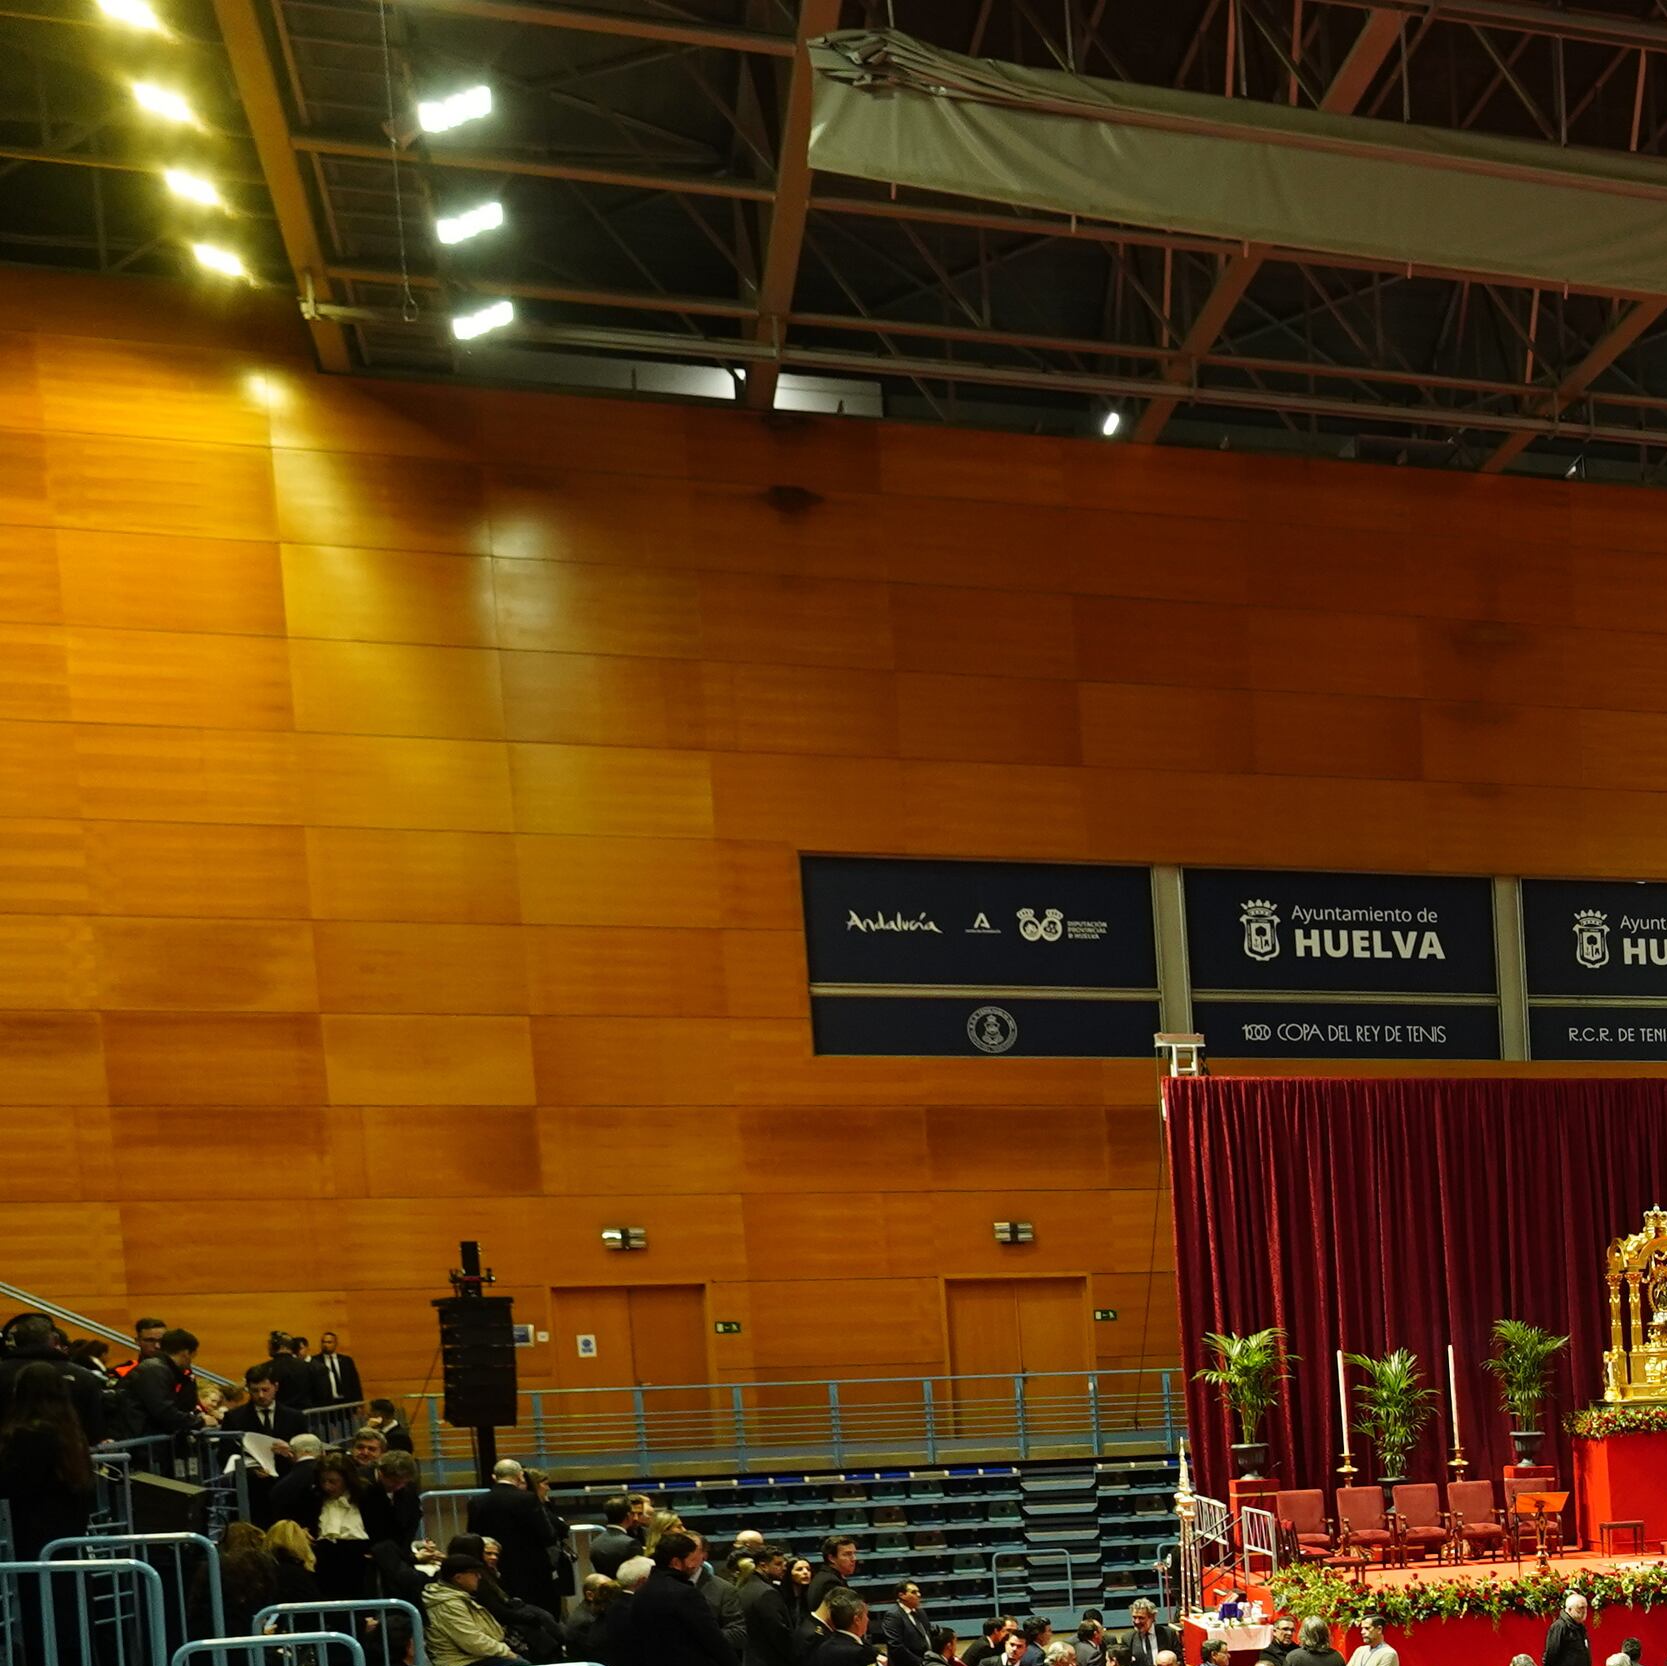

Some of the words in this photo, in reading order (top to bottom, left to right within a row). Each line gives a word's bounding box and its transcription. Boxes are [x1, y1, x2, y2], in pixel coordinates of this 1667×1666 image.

[847, 910, 943, 934] Andalucía
[1292, 905, 1412, 925] Ayuntamiento
[1417, 908, 1438, 924] de
[1295, 929, 1446, 960] HUELVA
[1277, 1023, 1324, 1042] COPA
[1328, 1024, 1352, 1042] DEL
[1356, 1025, 1380, 1042] REY
[1385, 1025, 1402, 1043] DE
[1407, 1025, 1447, 1043] TENIS
[1568, 1027, 1613, 1042] R.C.R.
[1618, 1028, 1635, 1042] DE
